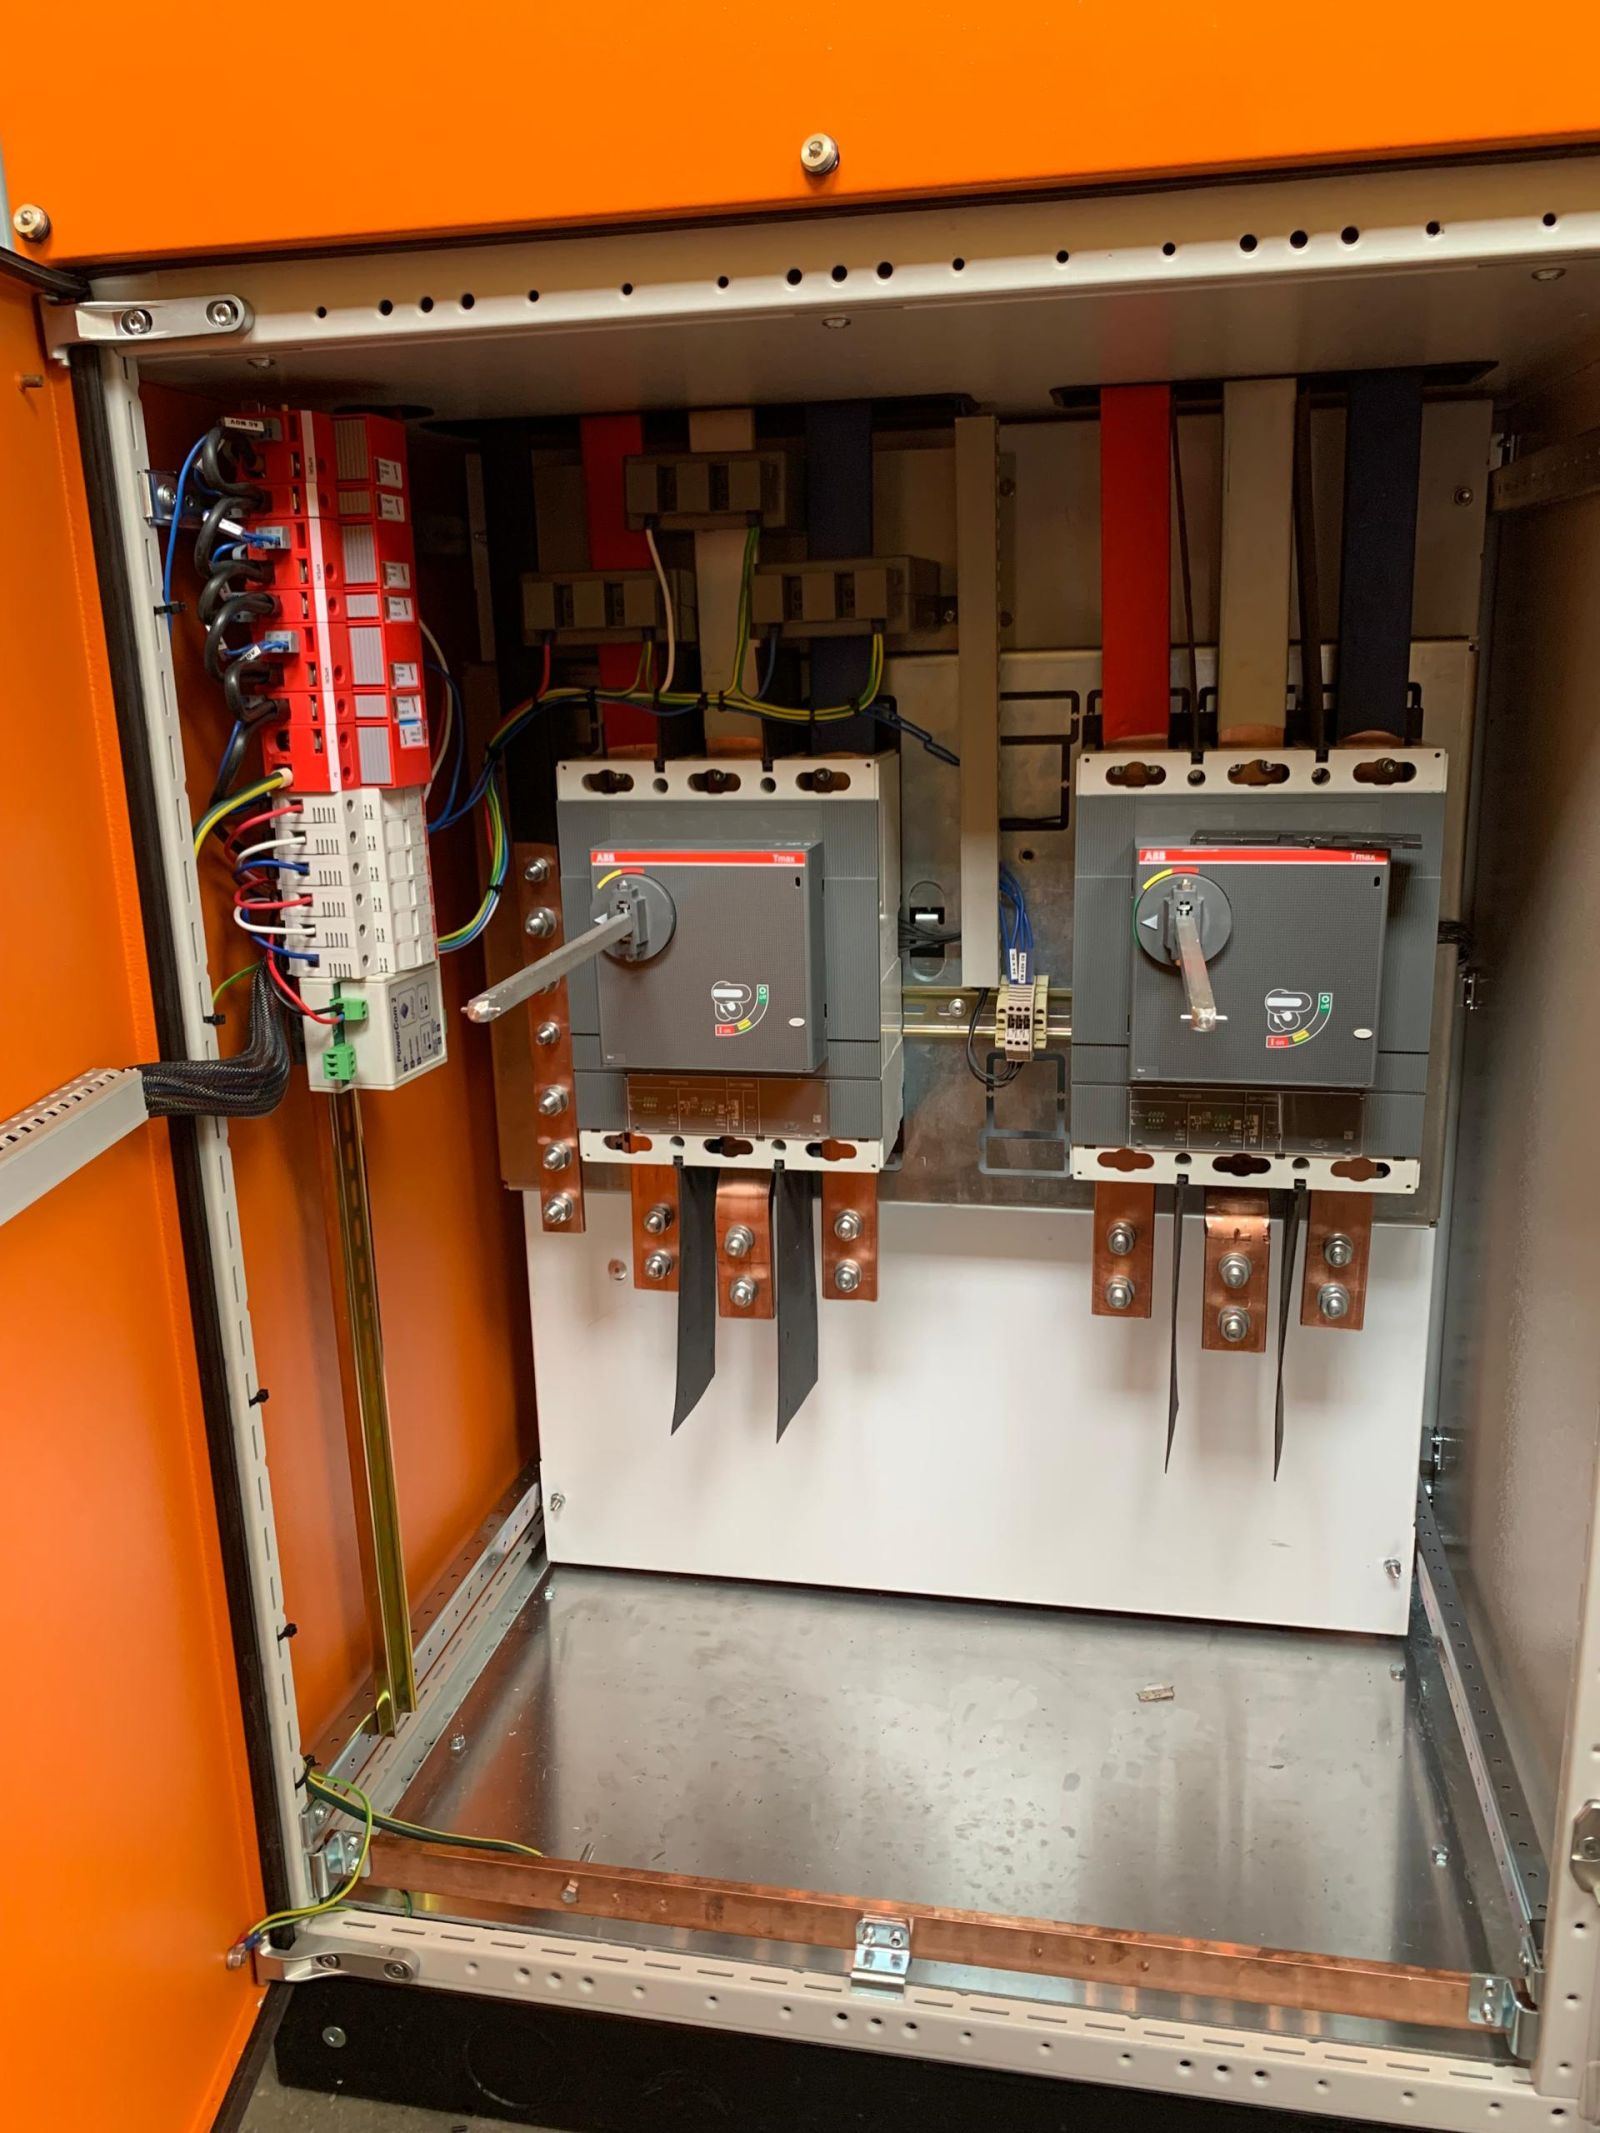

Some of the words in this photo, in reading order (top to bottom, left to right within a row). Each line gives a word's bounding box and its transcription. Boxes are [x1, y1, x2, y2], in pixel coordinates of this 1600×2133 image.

[596, 852, 616, 863] ABB
[772, 853, 796, 864] Tmax
[1144, 851, 1166, 862] ABB
[1350, 852, 1376, 862] Tmax
[392, 1005, 401, 1063] PowerCom
